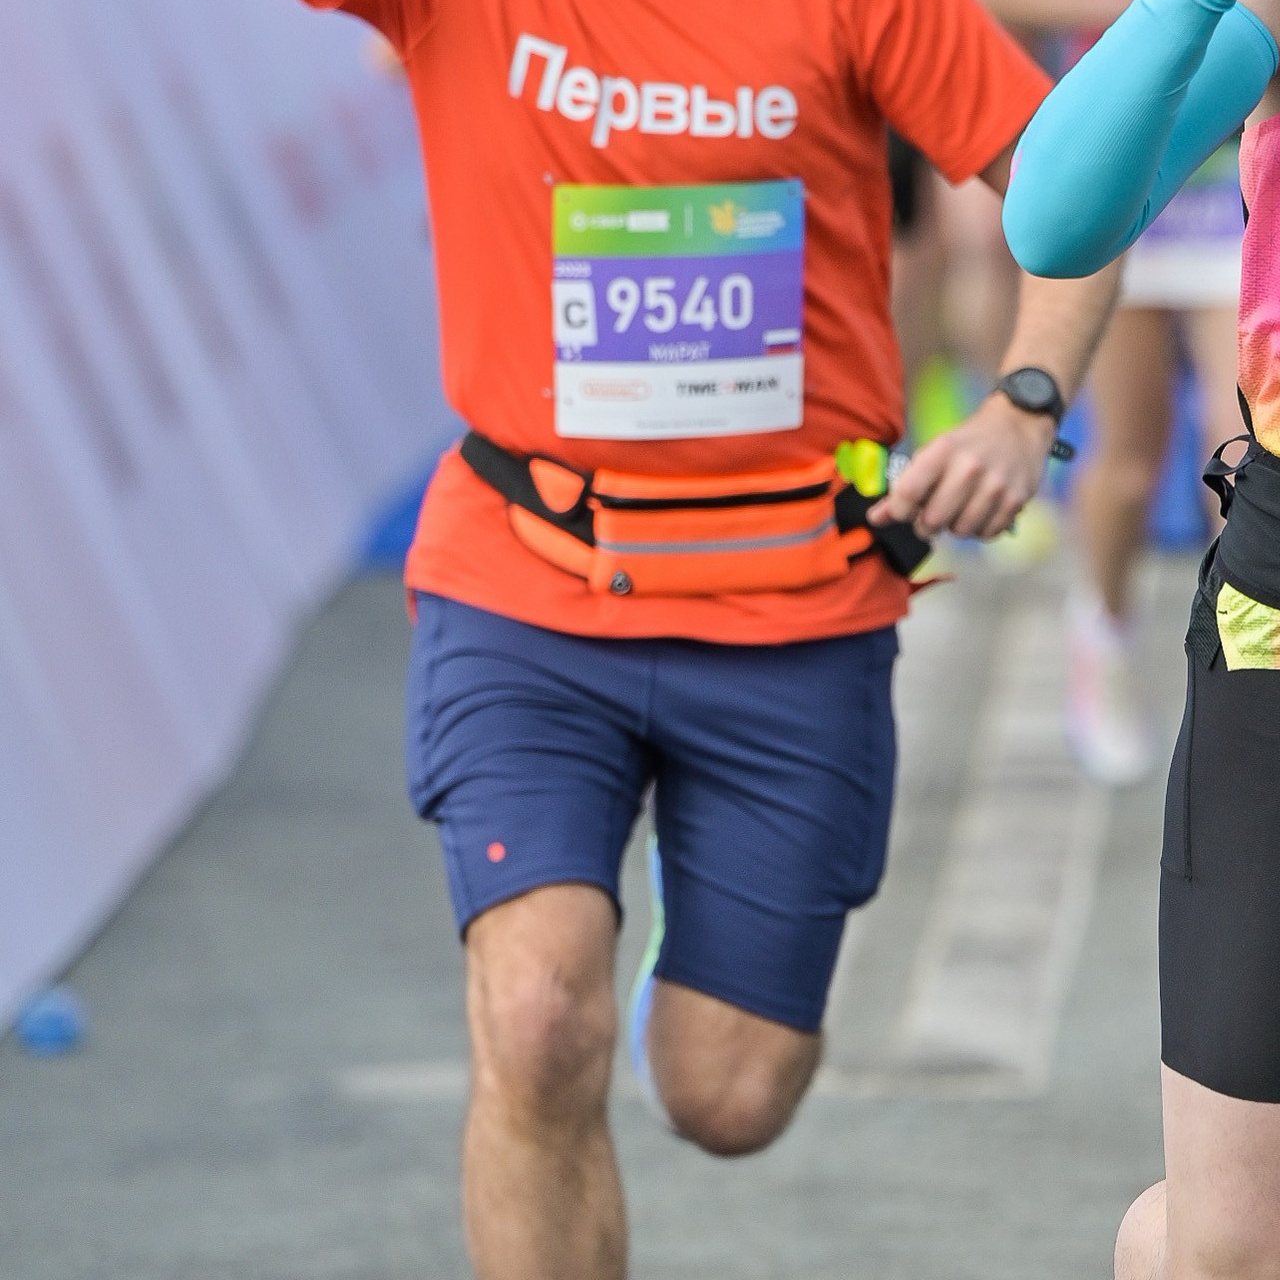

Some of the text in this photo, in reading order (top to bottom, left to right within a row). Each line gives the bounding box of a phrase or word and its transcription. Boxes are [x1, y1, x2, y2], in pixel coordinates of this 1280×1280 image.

[508, 33, 799, 148] Первые
[562, 273, 755, 333] C 9540
